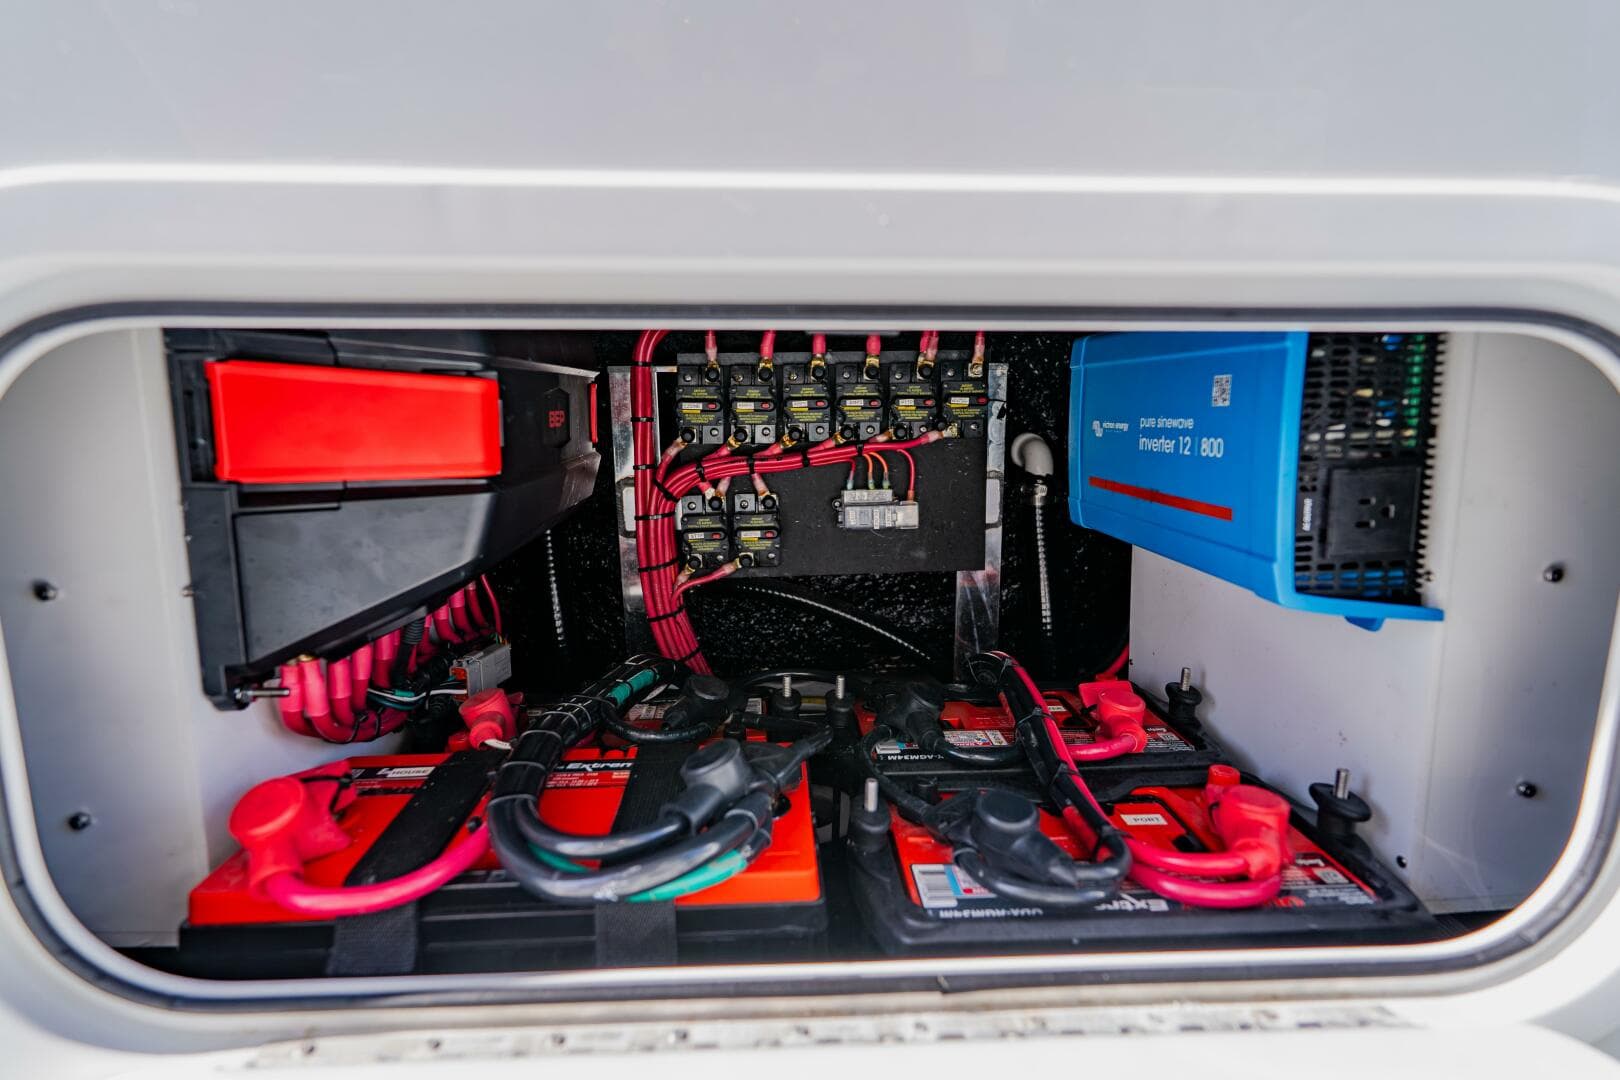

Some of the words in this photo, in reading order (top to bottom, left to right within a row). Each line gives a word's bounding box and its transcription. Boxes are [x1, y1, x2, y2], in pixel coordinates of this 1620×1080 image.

[549, 411, 565, 427] BEP
[1140, 417, 1156, 429] pure
[1157, 416, 1194, 429] sinewave
[1139, 434, 1176, 453] inverter
[1178, 436, 1191, 455] 12
[1201, 437, 1224, 458] 800
